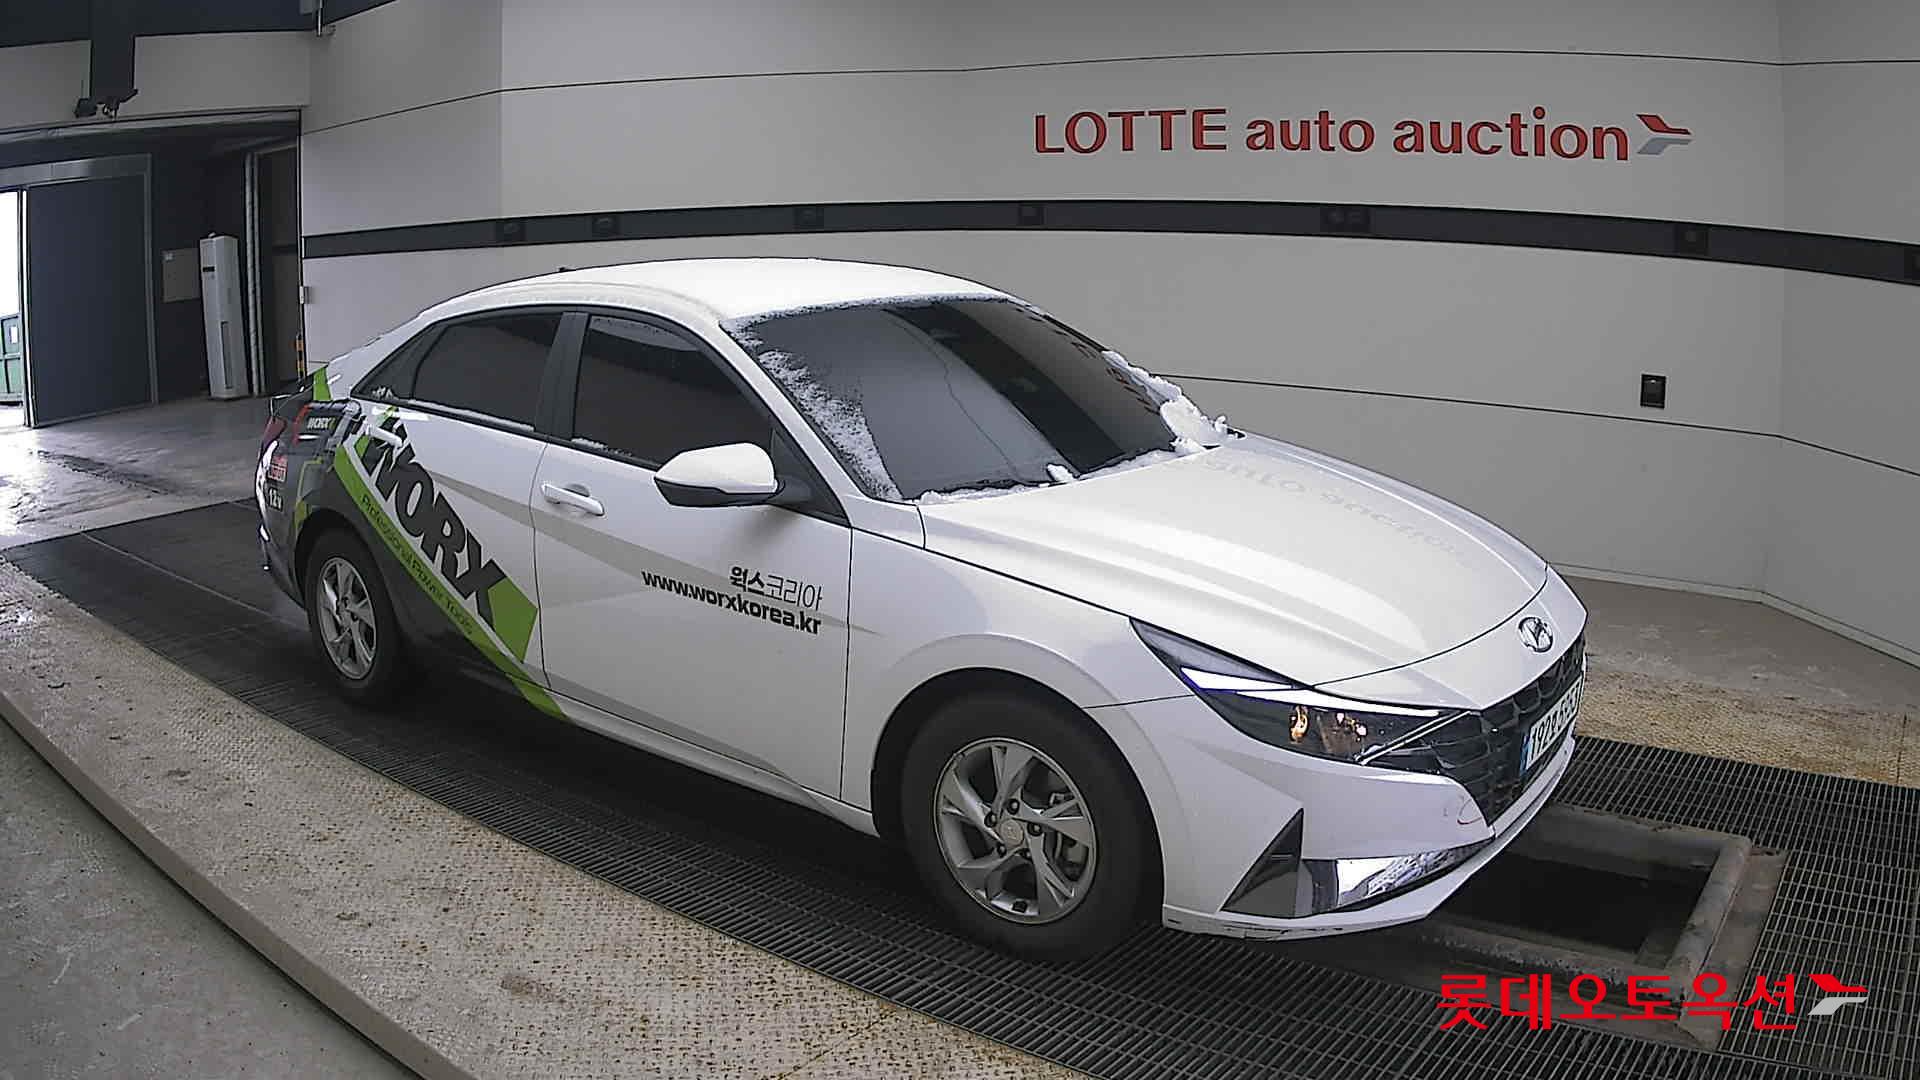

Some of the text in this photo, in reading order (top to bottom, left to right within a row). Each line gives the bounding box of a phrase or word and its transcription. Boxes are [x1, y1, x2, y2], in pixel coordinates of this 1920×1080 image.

[1034, 105, 1630, 161] LOTTE auto auction
[361, 415, 507, 627] WORX
[640, 570, 822, 635] www.worxkorea.kr
[729, 566, 823, 611] 웍스코리아
